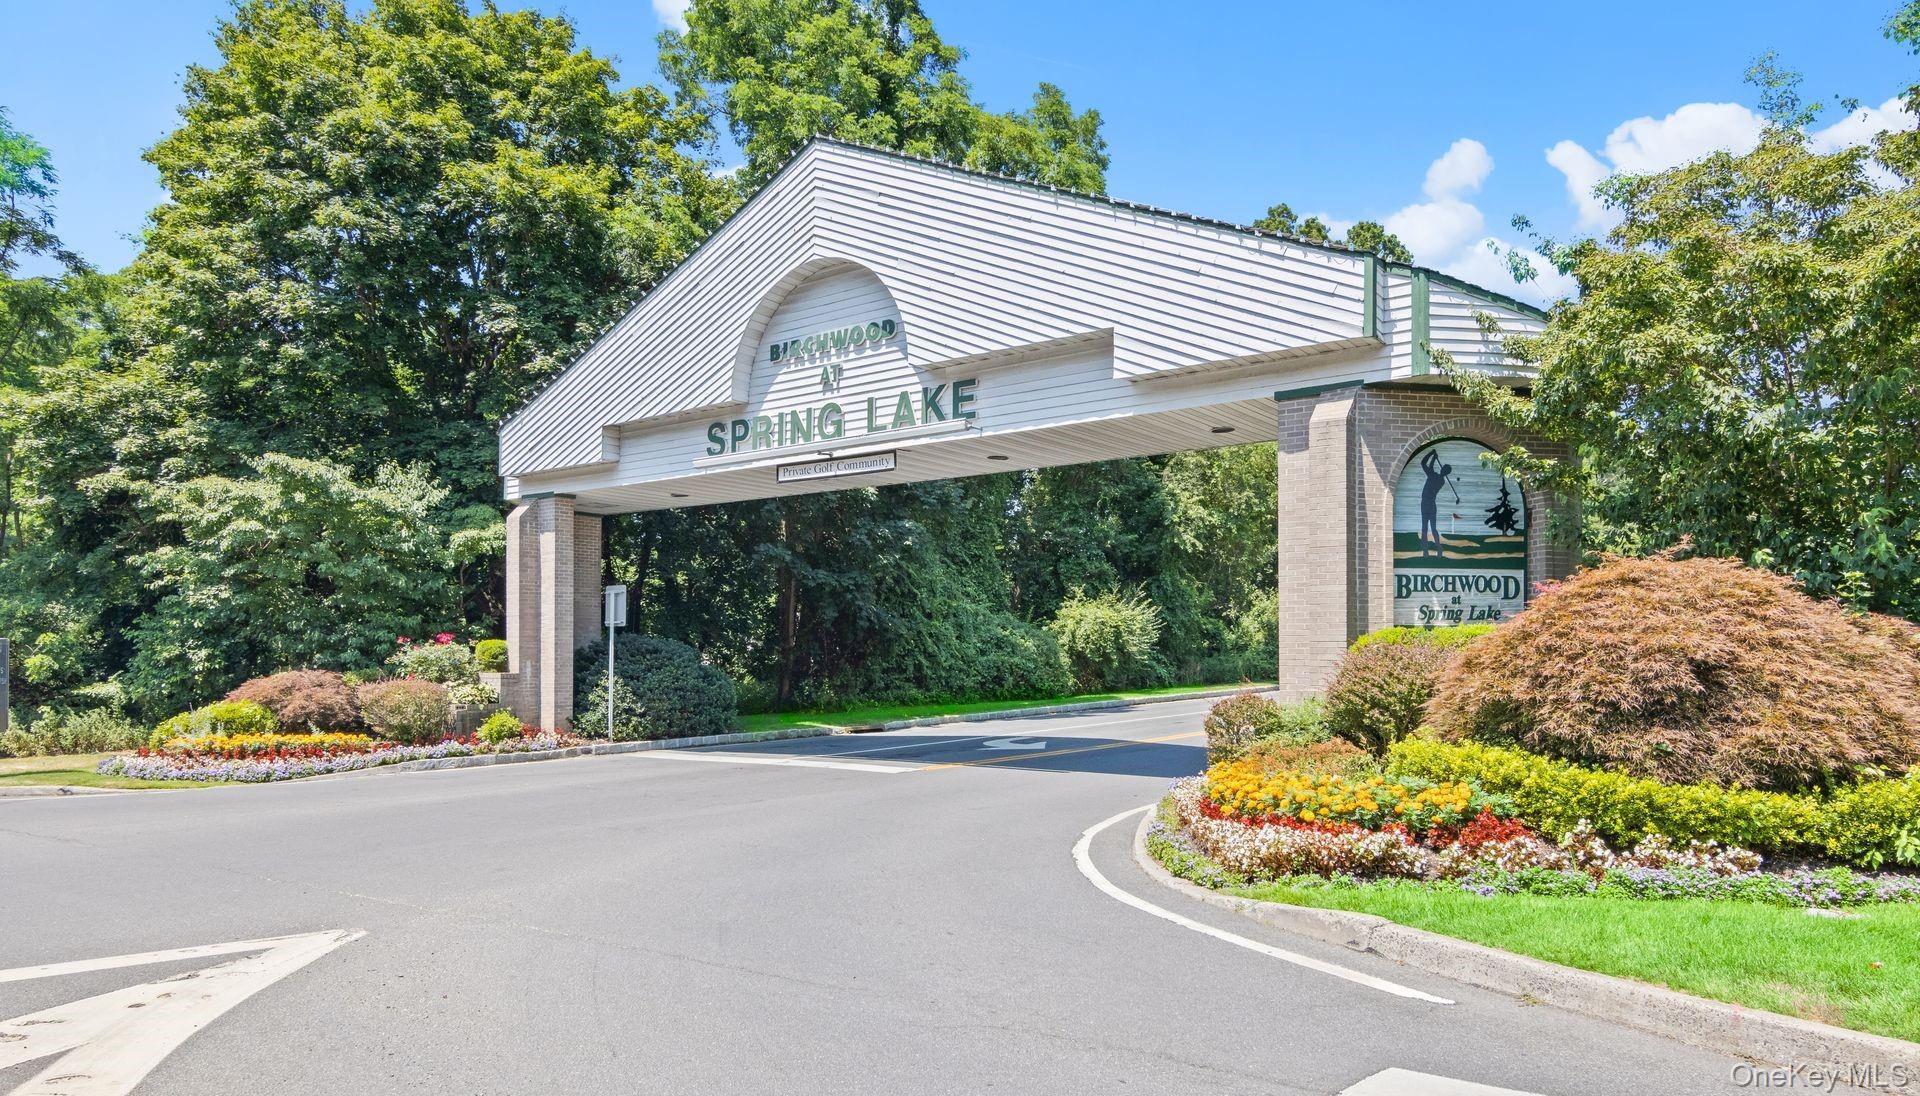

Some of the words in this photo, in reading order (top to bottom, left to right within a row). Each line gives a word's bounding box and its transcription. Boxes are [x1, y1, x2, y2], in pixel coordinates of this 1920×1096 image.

[769, 318, 897, 363] BIRCHWOOD
[820, 364, 843, 385] AT
[706, 402, 845, 456] SPRING
[867, 378, 979, 433] LAKE
[783, 466, 811, 477] Private
[814, 462, 834, 474] Golf
[836, 457, 890, 471] Community
[1394, 574, 1521, 600] BIRCHWOOD
[1451, 595, 1462, 605] at
[1418, 605, 1463, 624] Spring
[1467, 605, 1501, 621] Lake
